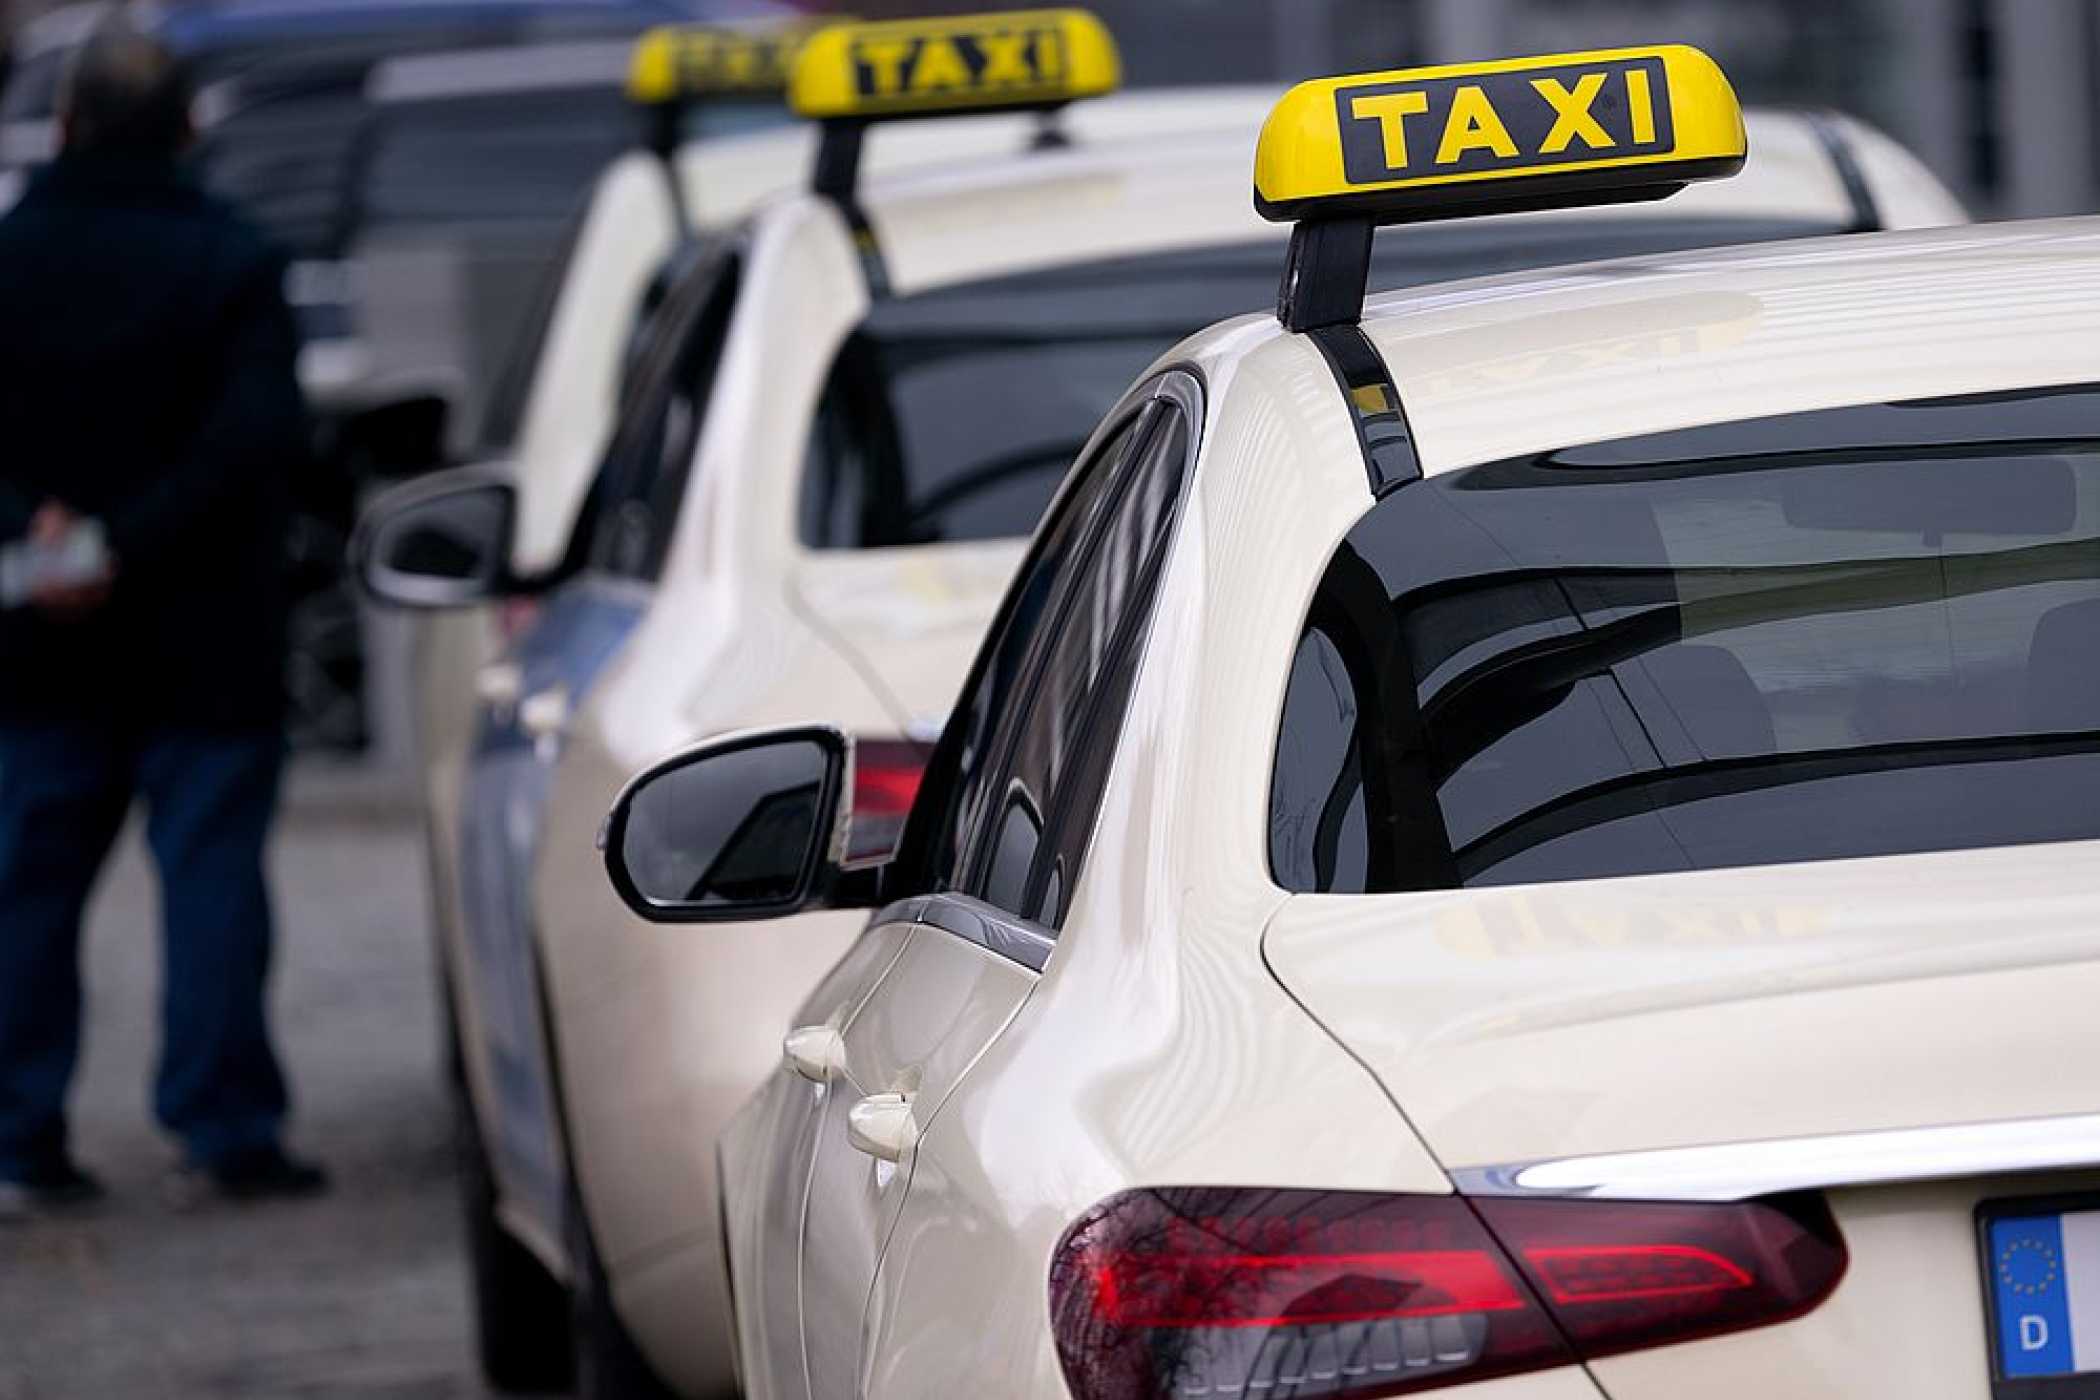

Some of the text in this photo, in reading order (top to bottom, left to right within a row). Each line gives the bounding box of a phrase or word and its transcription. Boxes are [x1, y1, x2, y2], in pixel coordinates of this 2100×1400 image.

[857, 32, 1058, 95] TAXI
[1351, 69, 1656, 169] TAXI
[2020, 1314, 2048, 1351] D
